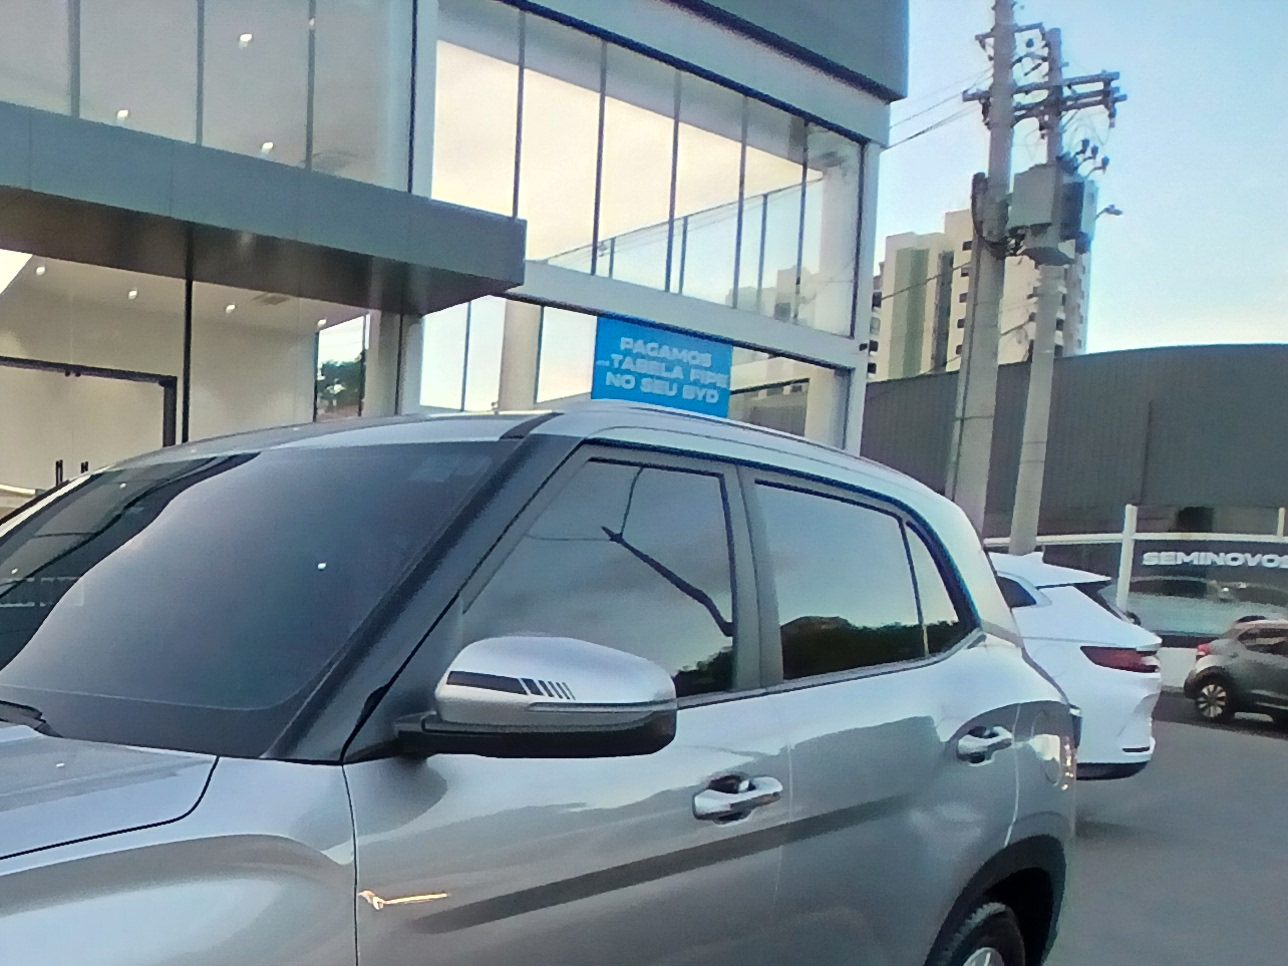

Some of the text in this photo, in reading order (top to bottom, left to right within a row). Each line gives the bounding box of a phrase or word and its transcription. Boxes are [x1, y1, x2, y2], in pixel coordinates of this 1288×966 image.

[610, 353, 684, 379] TABELA
[620, 337, 712, 368] PAGAMOS
[605, 371, 719, 404] NO SEU BYD
